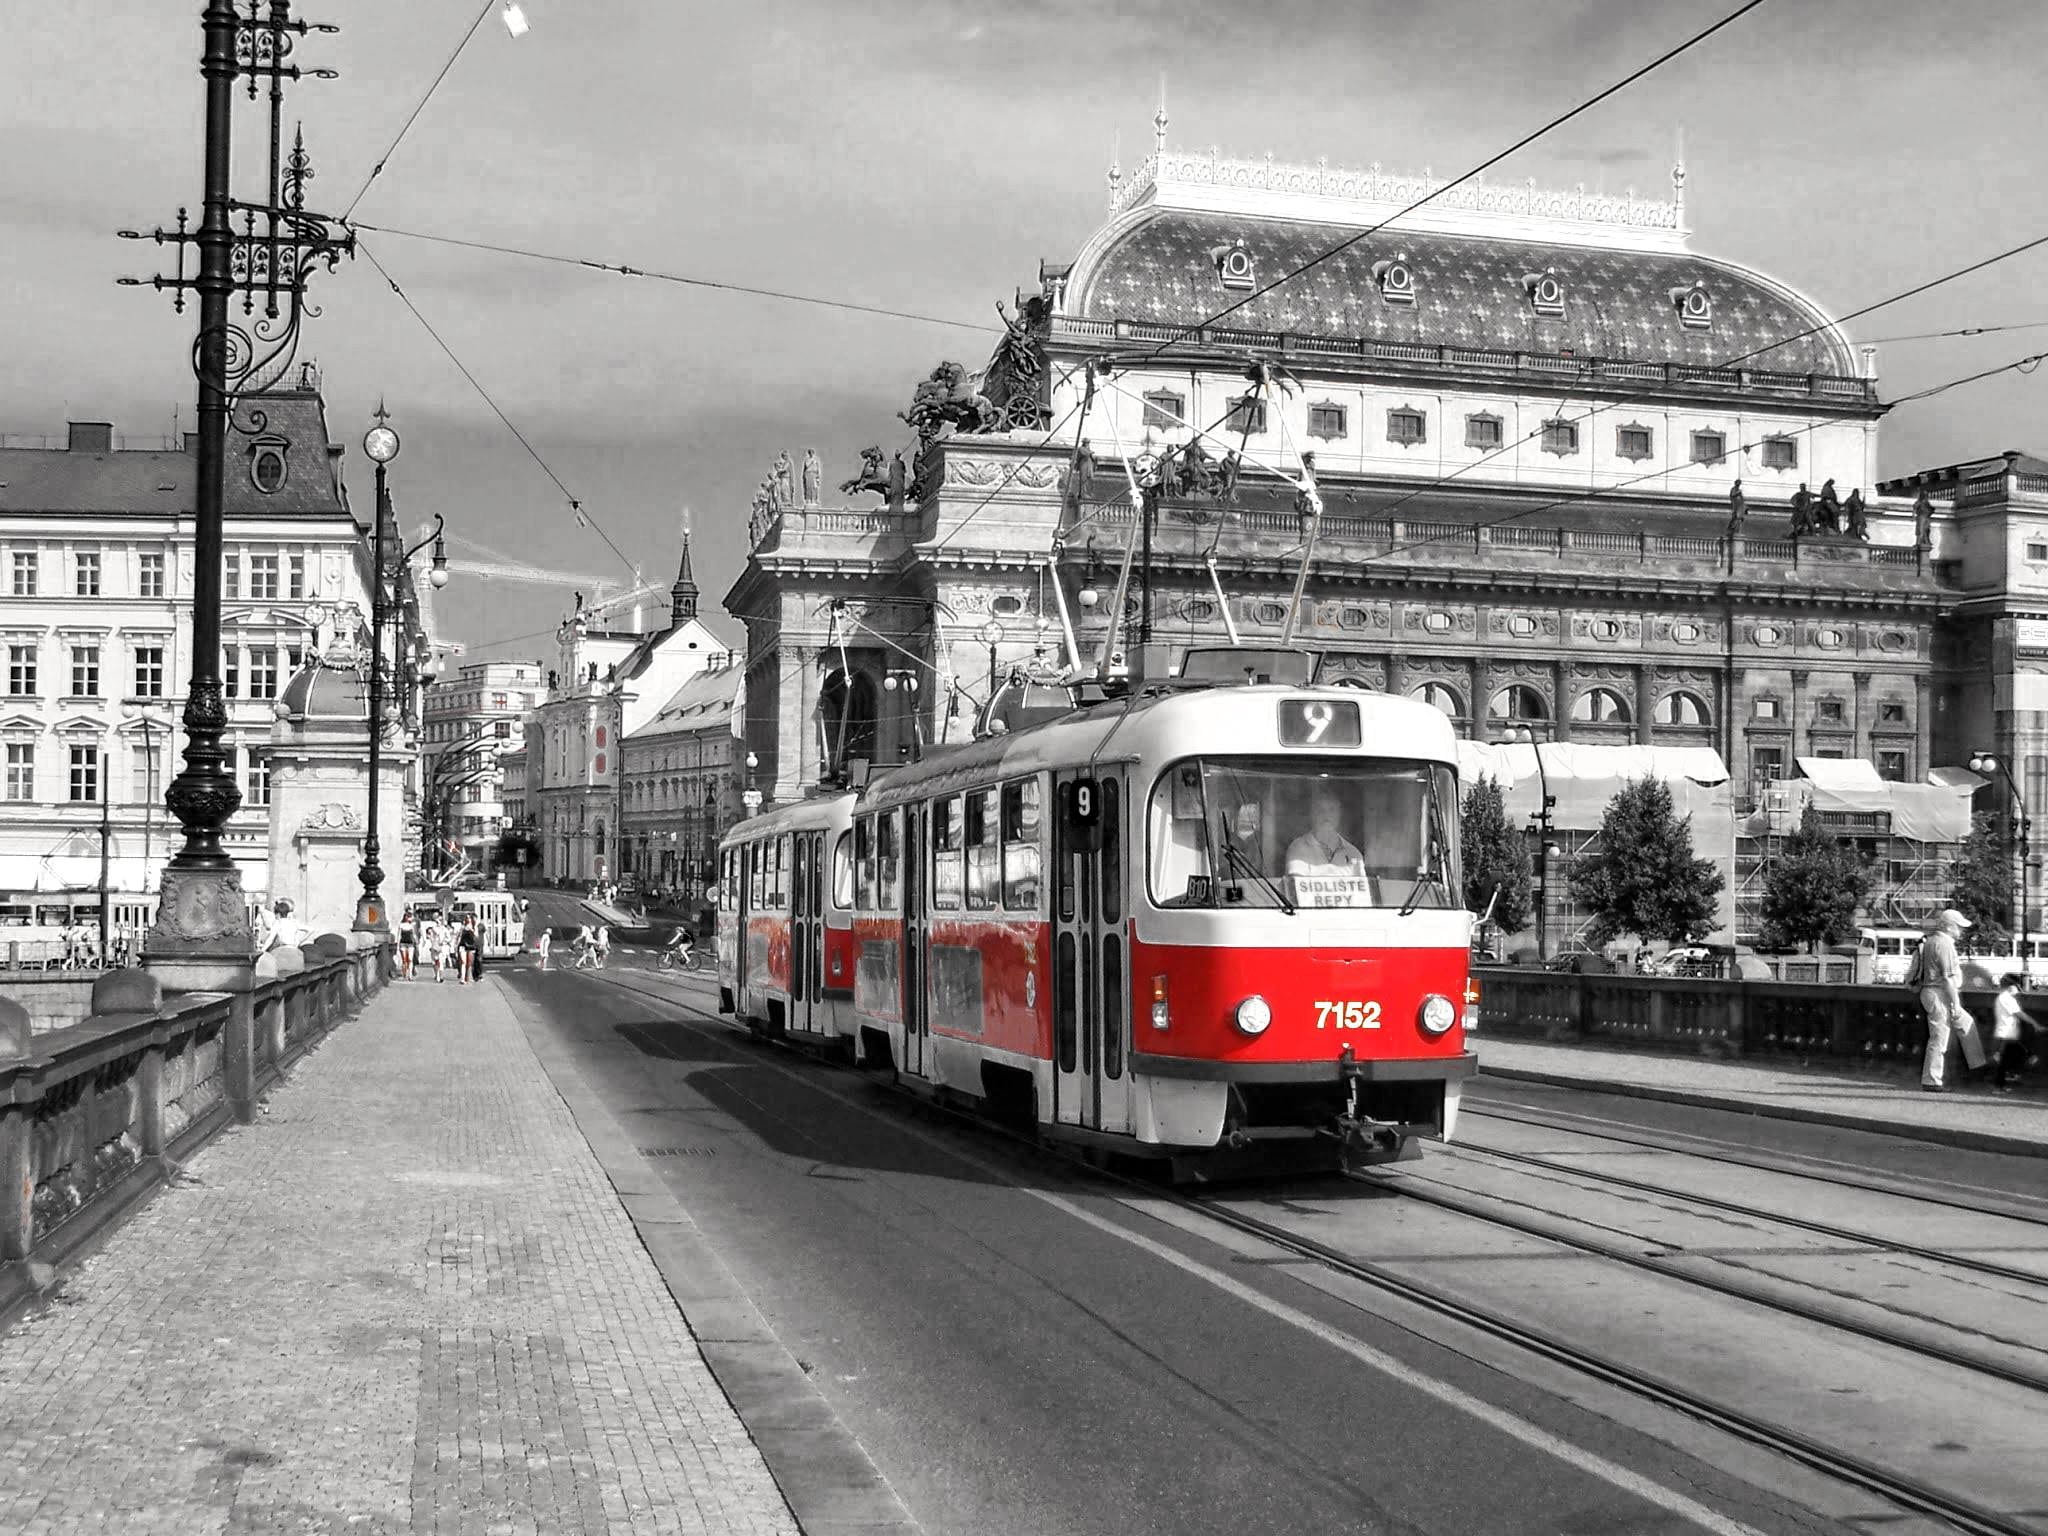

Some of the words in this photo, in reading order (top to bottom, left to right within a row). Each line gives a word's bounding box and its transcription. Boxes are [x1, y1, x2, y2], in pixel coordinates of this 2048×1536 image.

[1303, 702, 1333, 743] 9
[1078, 786, 1091, 817] 9
[1314, 1001, 1382, 1028] 7152
